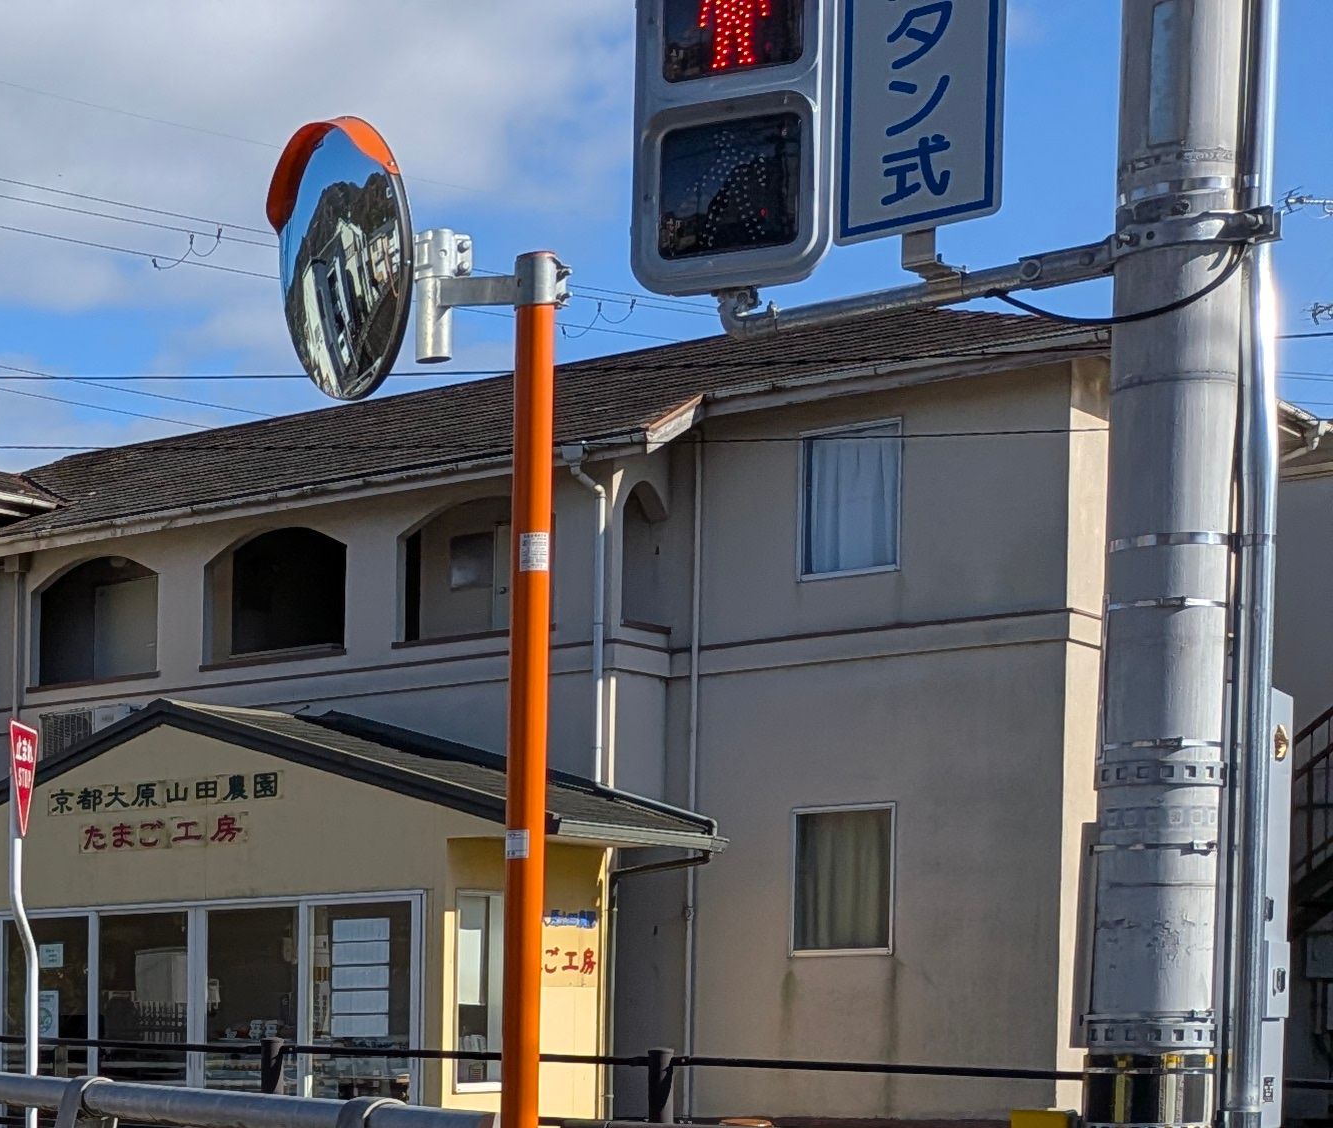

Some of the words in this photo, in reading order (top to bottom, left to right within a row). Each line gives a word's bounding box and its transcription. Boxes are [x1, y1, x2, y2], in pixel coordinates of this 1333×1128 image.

[881, 0, 952, 206] タン式
[15, 735, 34, 764] 止まれ
[18, 767, 32, 789] STOP
[50, 772, 278, 814] 京都大原山田農園
[84, 814, 244, 850] たまご工房
[541, 947, 596, 975] ご工房
